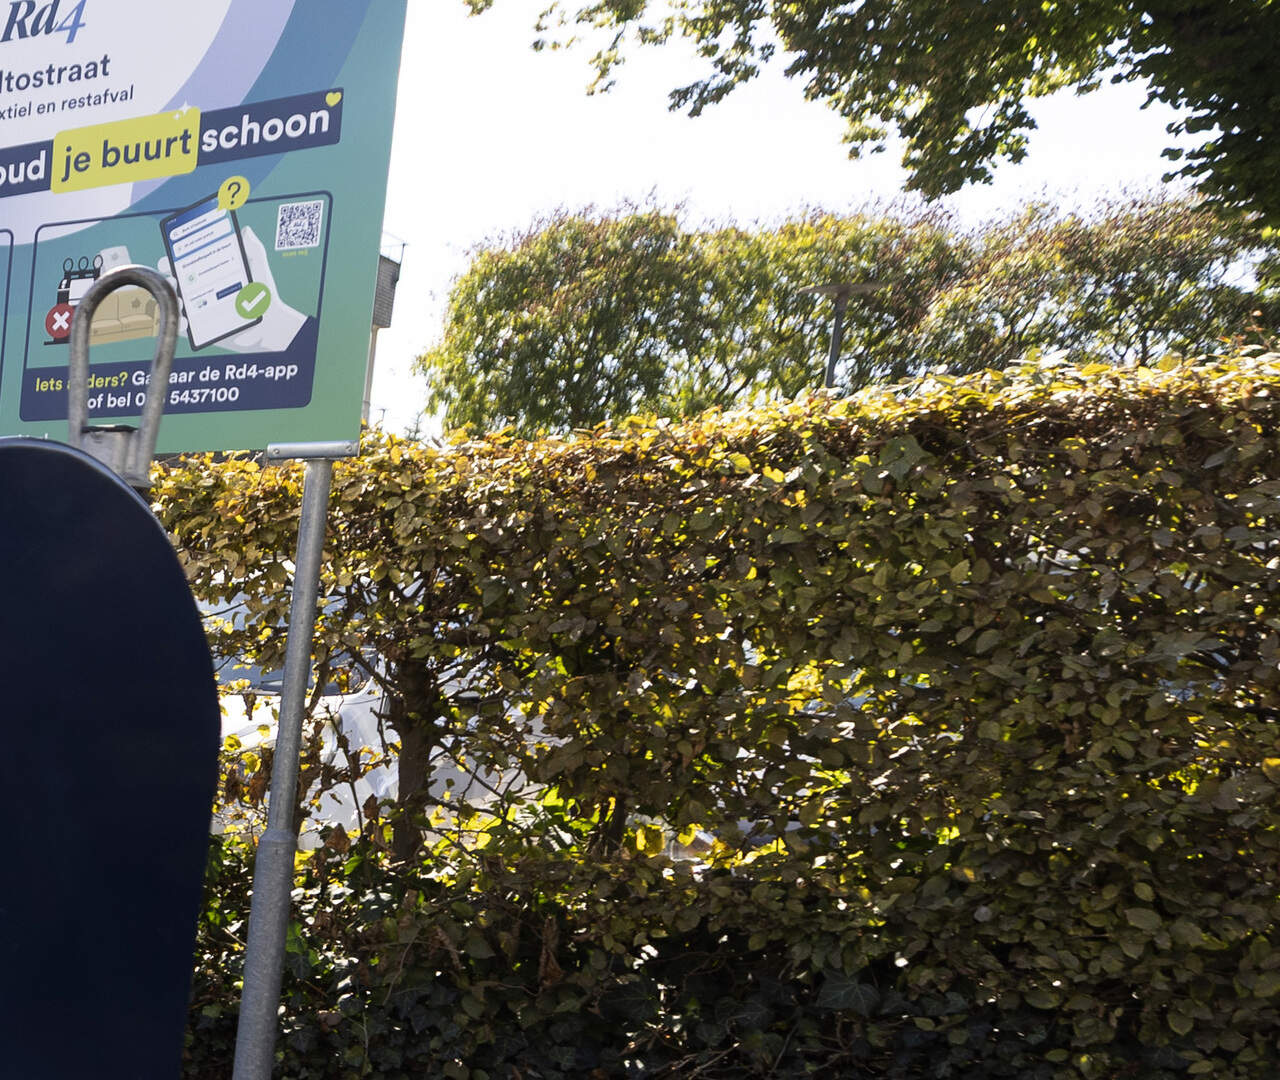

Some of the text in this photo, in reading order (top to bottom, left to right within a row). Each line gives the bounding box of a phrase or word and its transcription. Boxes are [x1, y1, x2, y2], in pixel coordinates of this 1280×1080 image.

[36, 100, 56, 115] en
[61, 84, 135, 111] restafval
[61, 146, 91, 182] je
[101, 129, 192, 168] buurt
[201, 109, 330, 152] schoon
[35, 377, 63, 392] Iets
[67, 372, 128, 390] ders?
[169, 371, 196, 384] aar
[199, 366, 220, 382] de
[225, 363, 298, 380] Rd4-app
[87, 393, 104, 409] of
[107, 391, 131, 408] bel
[170, 386, 240, 405] 5437100
